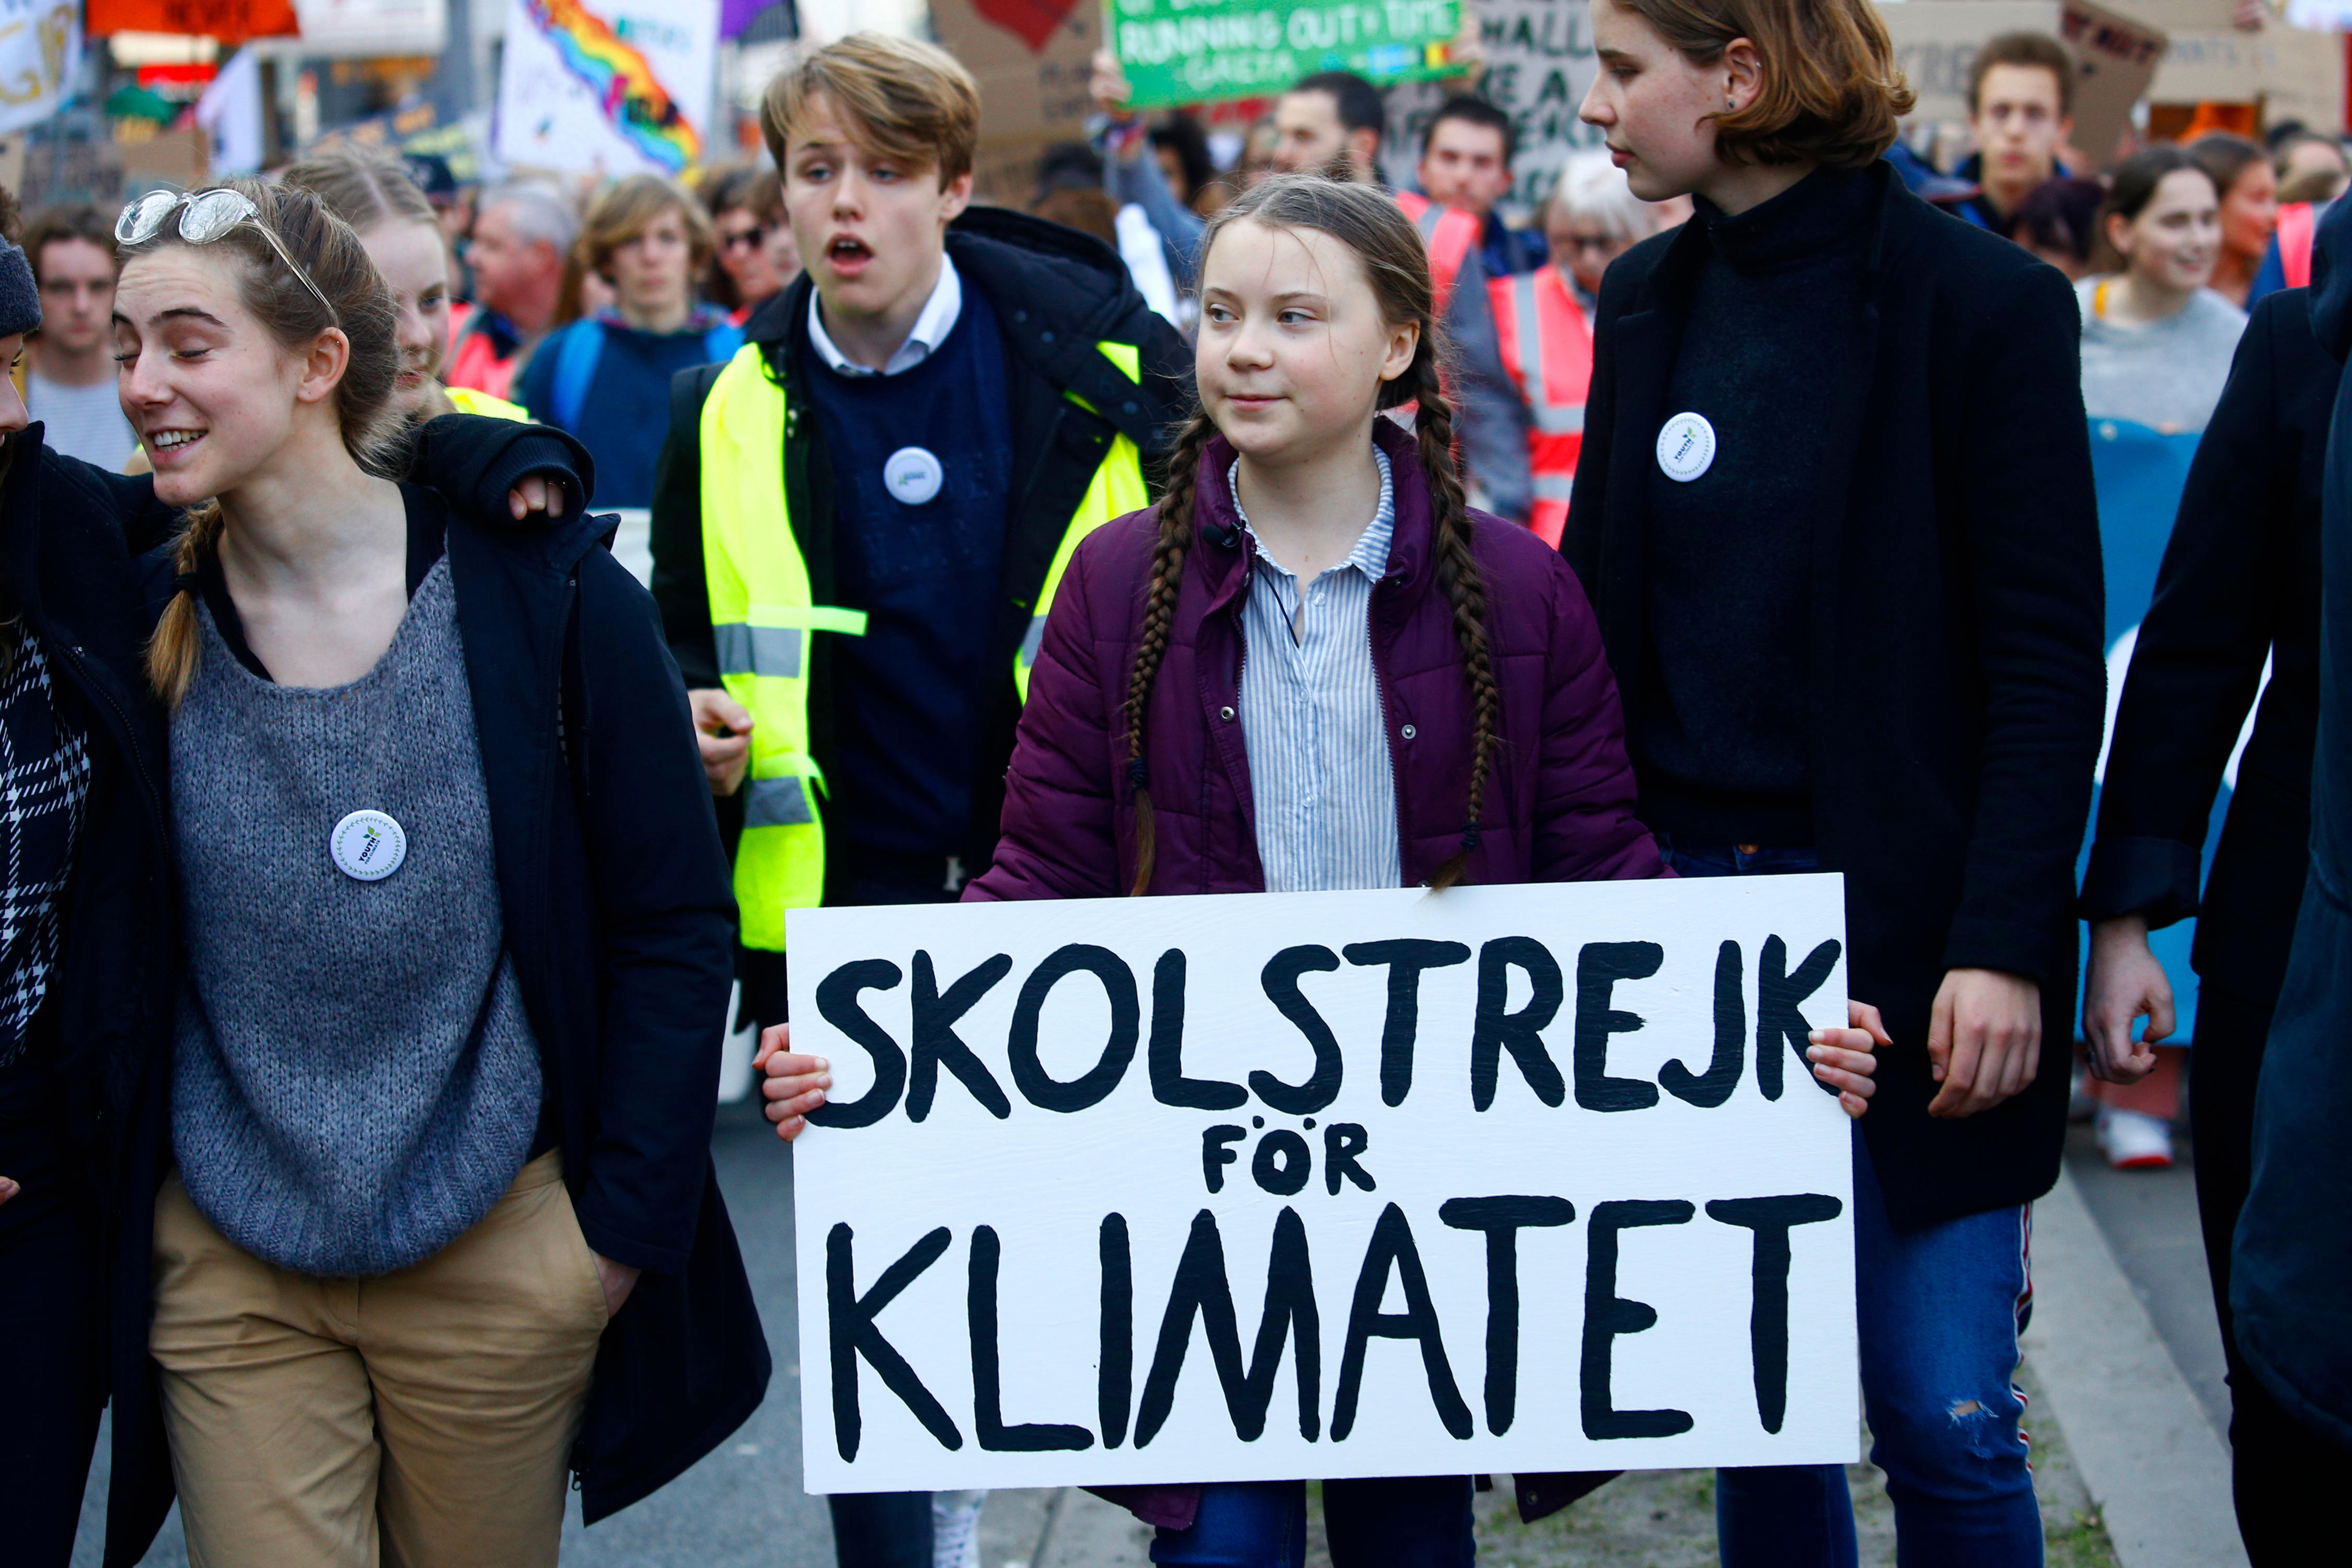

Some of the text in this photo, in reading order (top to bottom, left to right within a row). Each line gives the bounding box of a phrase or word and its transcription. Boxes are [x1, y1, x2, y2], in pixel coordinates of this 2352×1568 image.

[1118, 10, 1282, 65] RUNNING
[1286, 4, 1358, 51] OUT
[1674, 437, 1691, 460] YOUTH
[359, 837, 377, 861] YOUTH
[369, 840, 381, 857] CLIMATE
[804, 934, 1843, 1129] SKOLSTREJK
[1203, 1115, 1376, 1196] FÖR
[826, 1193, 1842, 1463] KLIMATET
